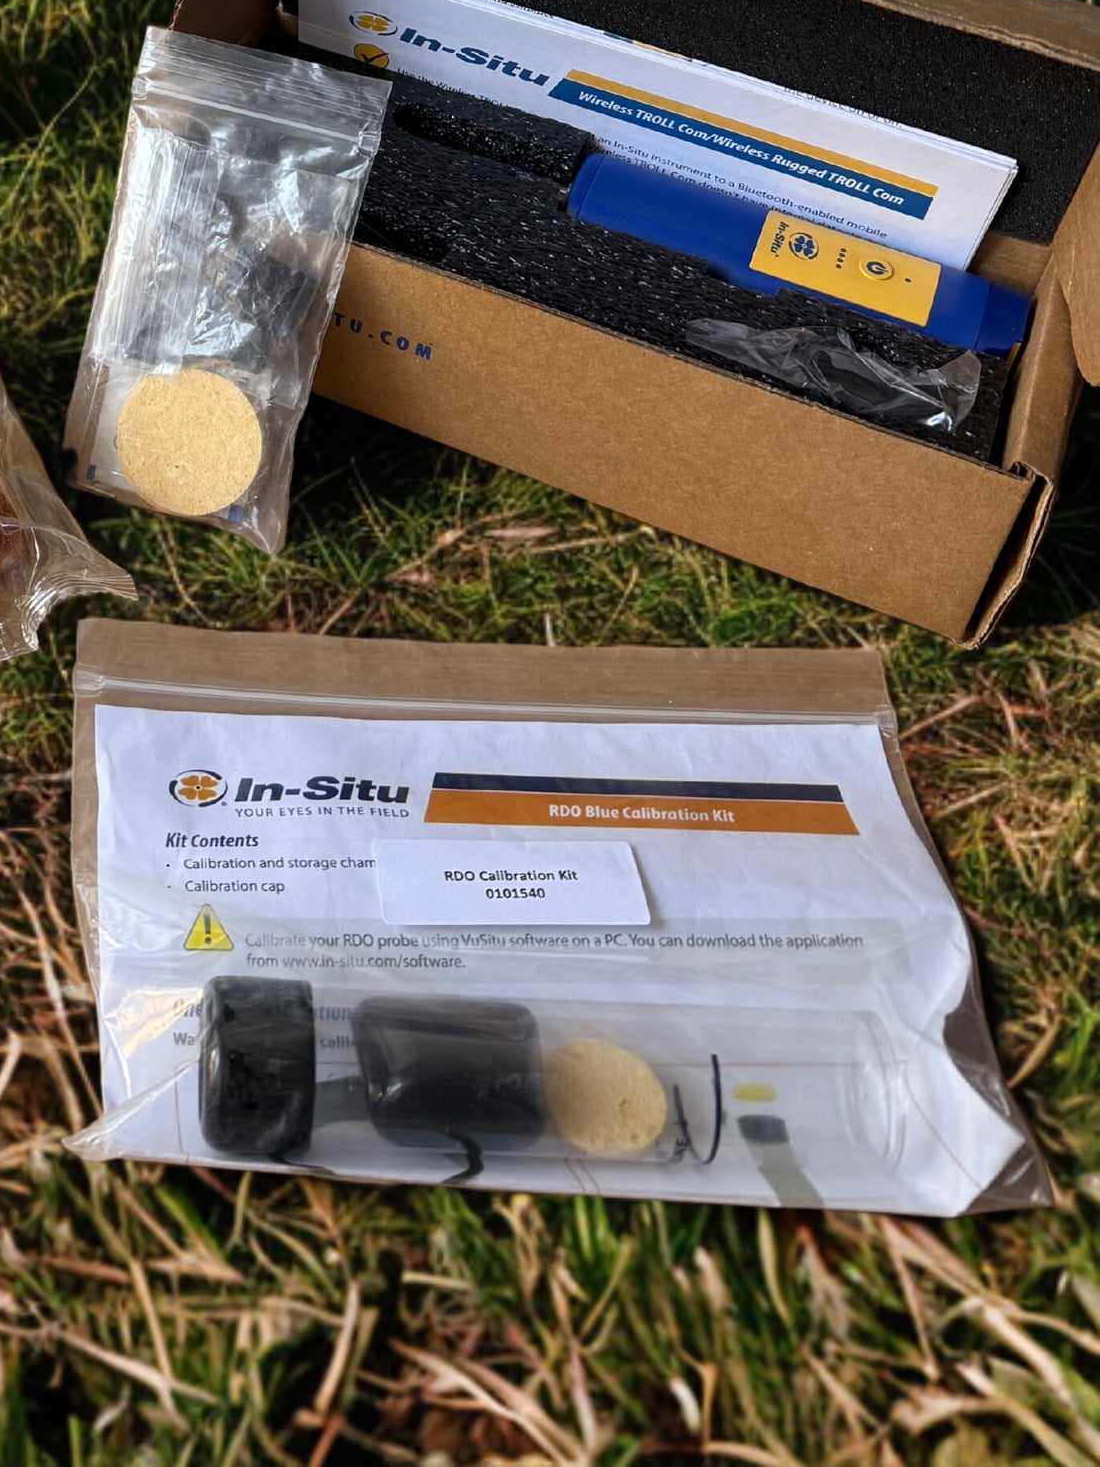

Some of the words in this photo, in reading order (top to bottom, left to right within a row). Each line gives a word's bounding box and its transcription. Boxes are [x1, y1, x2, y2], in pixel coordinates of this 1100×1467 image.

[400, 27, 550, 87] In-Situ
[578, 90, 633, 116] Wireless
[636, 108, 675, 130] TROLL
[677, 123, 770, 160] Com/Wireless
[770, 154, 828, 179] Rugged
[829, 172, 870, 194] TROLL
[872, 188, 905, 205] Com
[598, 136, 612, 146] an
[613, 139, 650, 159] In-Situ
[651, 153, 712, 180] instrument
[714, 174, 727, 184] to
[728, 179, 736, 188] a
[737, 181, 846, 225] Bluetooth-enabled
[846, 219, 888, 239] mobile
[770, 220, 790, 255] In-Situ
[234, 775, 410, 804] In-Situ
[235, 807, 274, 818] YOUR
[279, 806, 313, 817] EYES
[318, 805, 333, 816] IN
[336, 805, 365, 816] THE
[370, 807, 410, 818] FIELD
[548, 803, 582, 820] RDO
[585, 804, 620, 821] Blue
[621, 805, 710, 823] Calibration
[712, 808, 736, 824] Kit
[165, 832, 188, 849] Kit
[191, 833, 260, 848] Contents
[183, 857, 256, 870] Calibration
[259, 857, 285, 869] and
[287, 857, 338, 871] storage
[444, 870, 476, 882] RDO
[479, 869, 556, 883] Calibration
[558, 869, 580, 882] Kit
[185, 880, 258, 894] Calibration
[261, 882, 286, 895] cap
[485, 886, 546, 900] 0101540
[244, 933, 307, 948] Calibrate
[308, 935, 341, 951] your
[343, 934, 374, 948] RDO
[377, 933, 420, 951] probe
[421, 934, 460, 951] using
[460, 933, 507, 948] VuSitu
[509, 933, 570, 948] software
[571, 935, 591, 947] on
[593, 936, 603, 947] a
[604, 933, 628, 948] PC.
[628, 933, 656, 948] You
[658, 935, 684, 948] can
[685, 933, 757, 948] download
[759, 933, 784, 948] the
[785, 933, 864, 951] application
[246, 954, 279, 969] from
[282, 954, 467, 970] www.in-situ.com/software.
